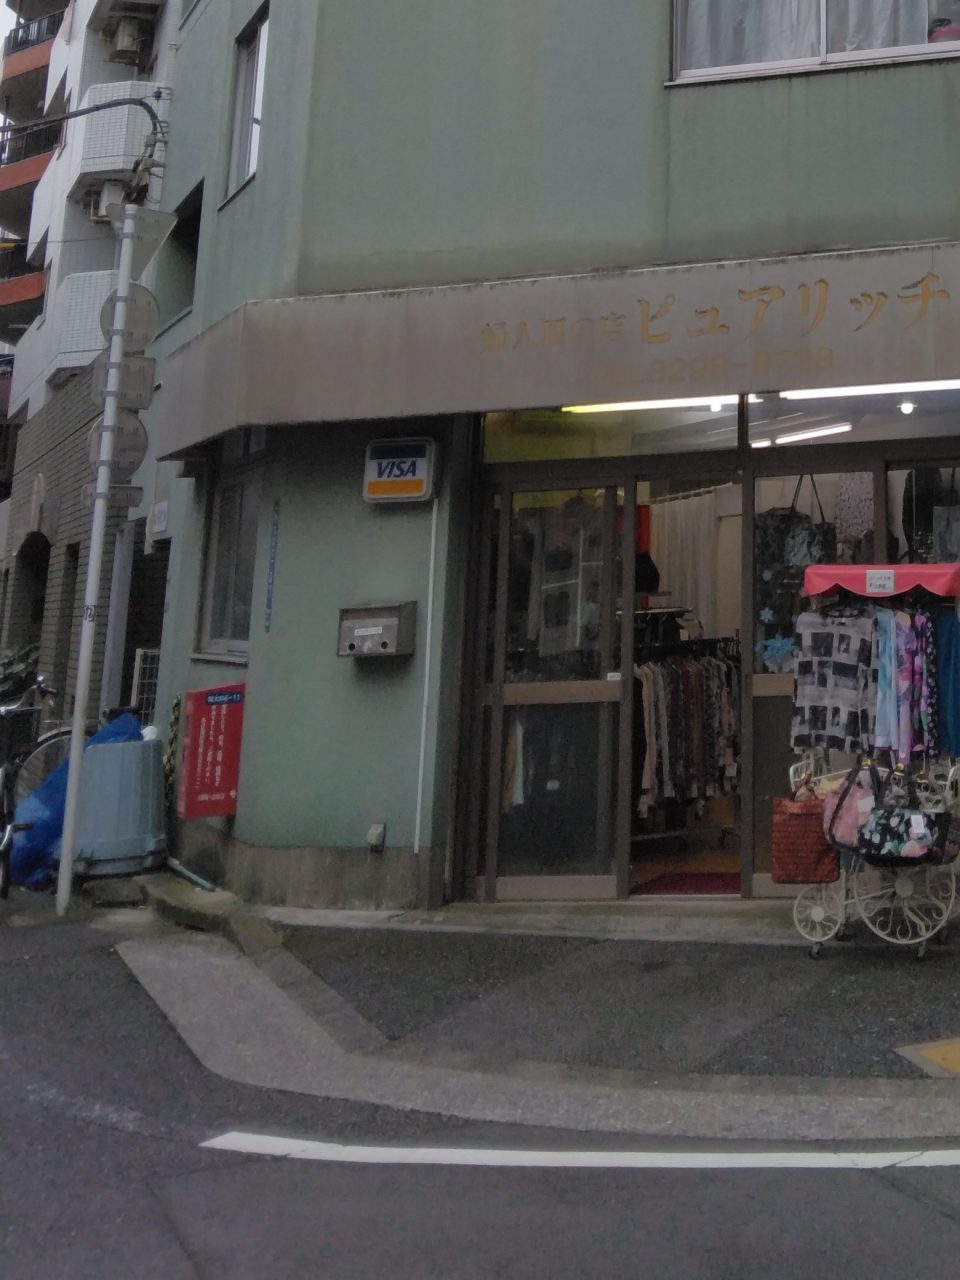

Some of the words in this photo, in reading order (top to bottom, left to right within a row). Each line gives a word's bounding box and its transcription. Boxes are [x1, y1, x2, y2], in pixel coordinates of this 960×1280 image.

[637, 271, 950, 345] ピュアリッチ
[377, 460, 417, 479] VISA
